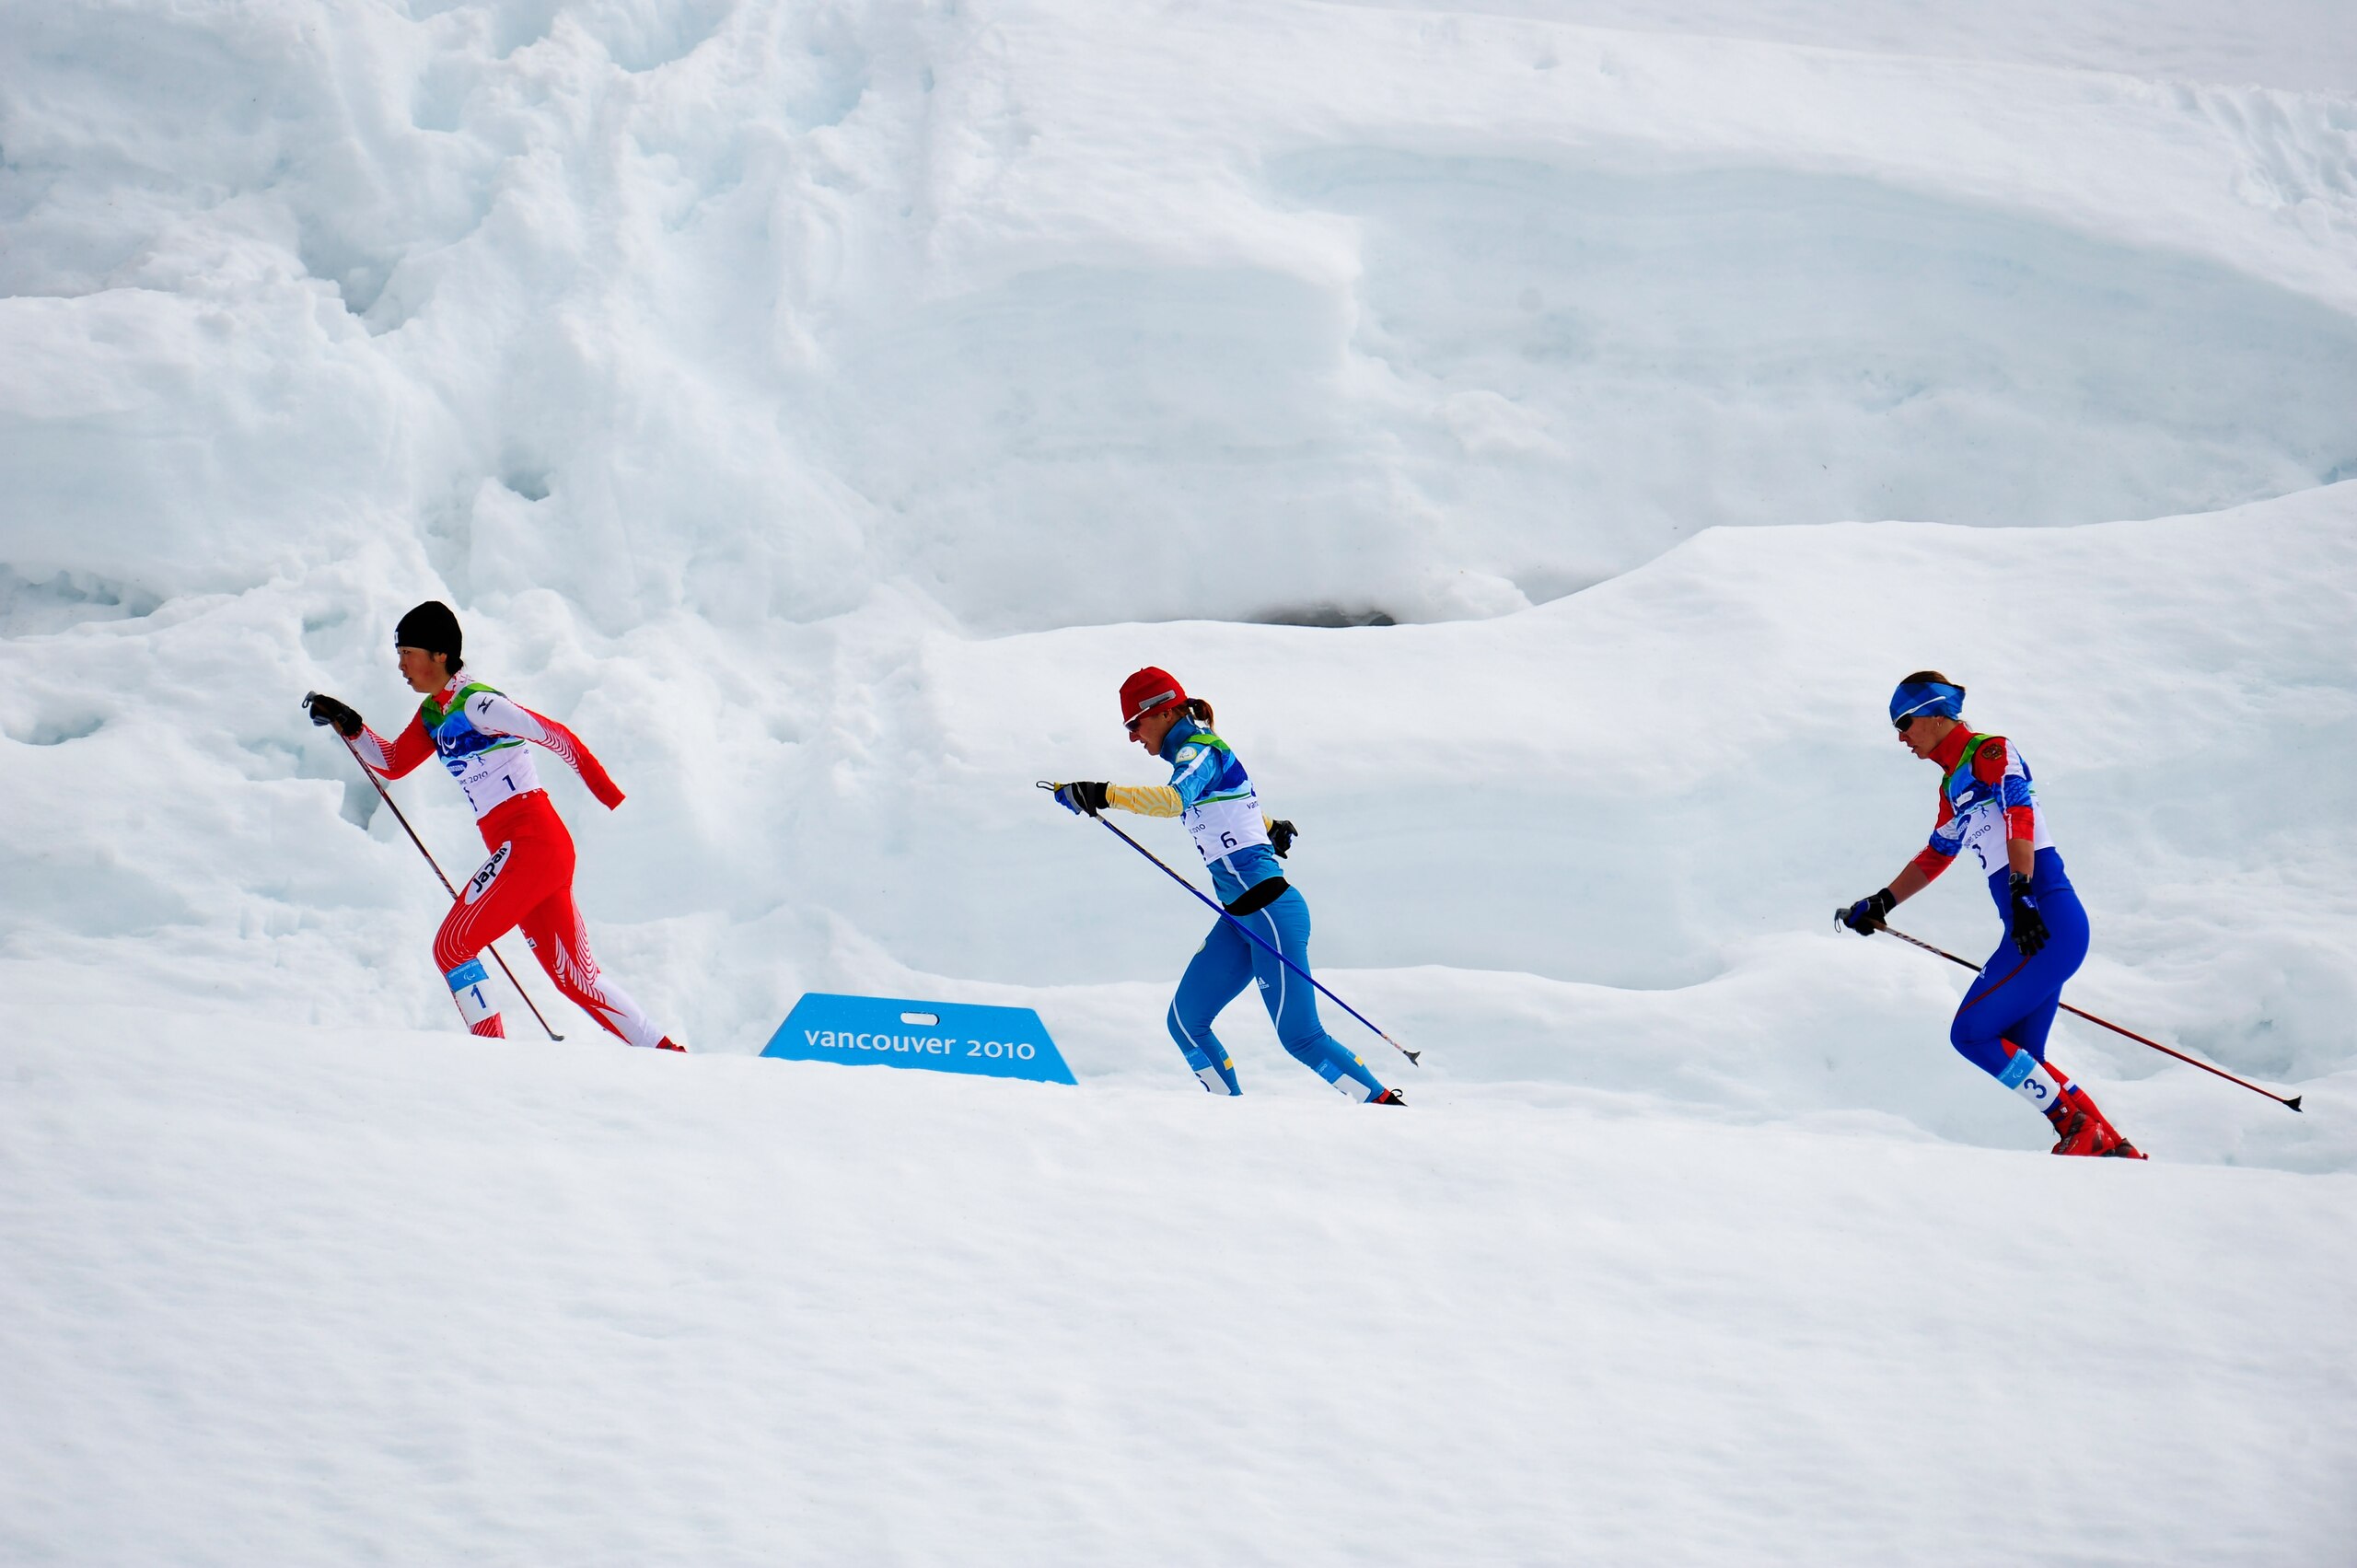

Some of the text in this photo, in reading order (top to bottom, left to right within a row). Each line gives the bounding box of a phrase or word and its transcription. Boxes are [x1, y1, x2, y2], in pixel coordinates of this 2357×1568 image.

[502, 774, 516, 791] 1
[1220, 830, 1237, 849] 6
[1972, 825, 1991, 839] 2010
[472, 847, 508, 893] Japan
[470, 984, 486, 1008] 1
[804, 1029, 1036, 1060] vancouver 2010
[2024, 1078, 2047, 1099] 3
